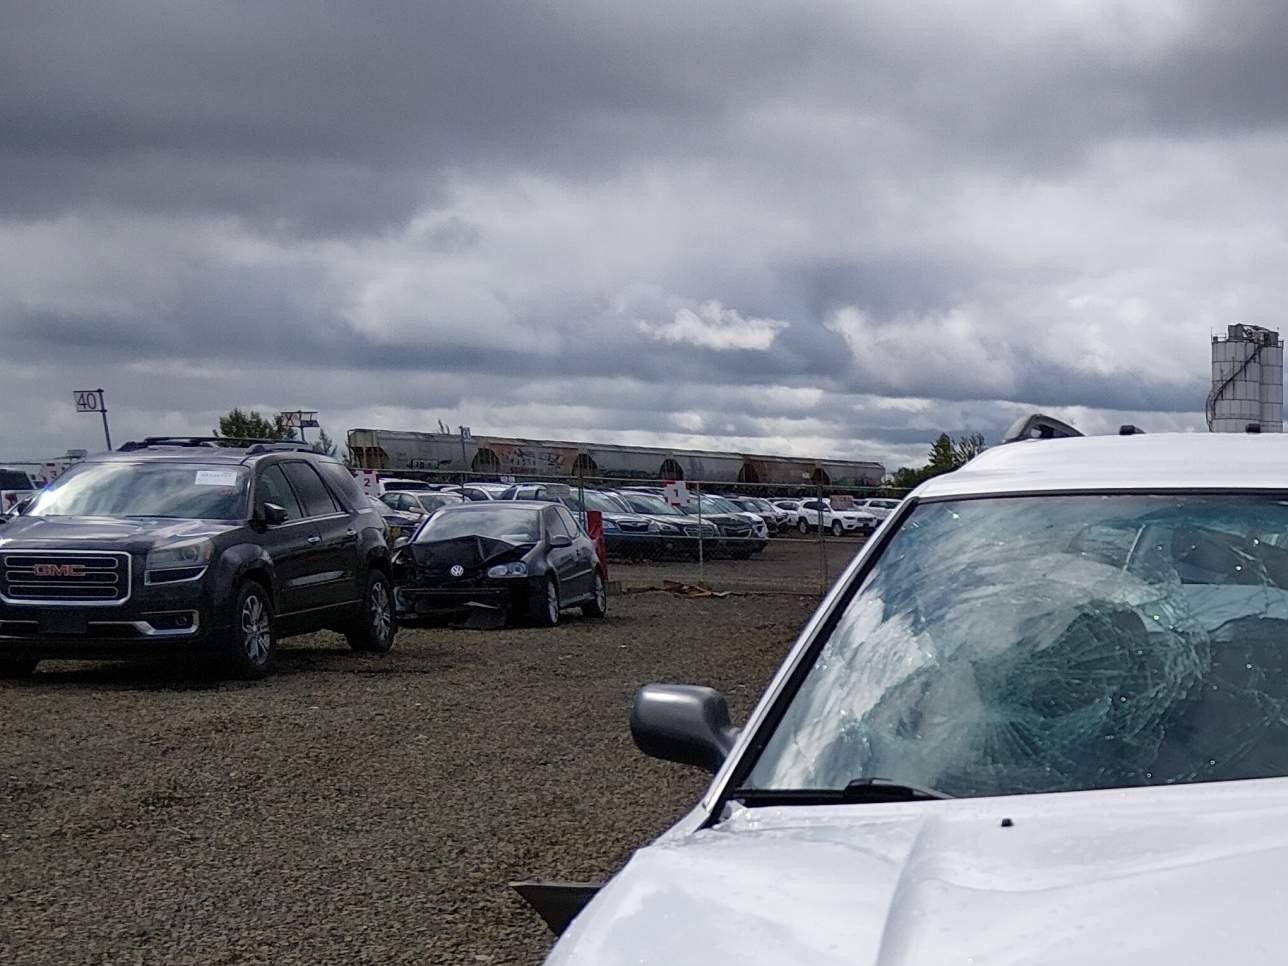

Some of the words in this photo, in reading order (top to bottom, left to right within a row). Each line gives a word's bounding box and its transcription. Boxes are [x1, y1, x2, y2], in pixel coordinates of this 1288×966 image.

[77, 392, 97, 410] 40
[363, 477, 372, 488] 2
[32, 563, 86, 576] GMC
